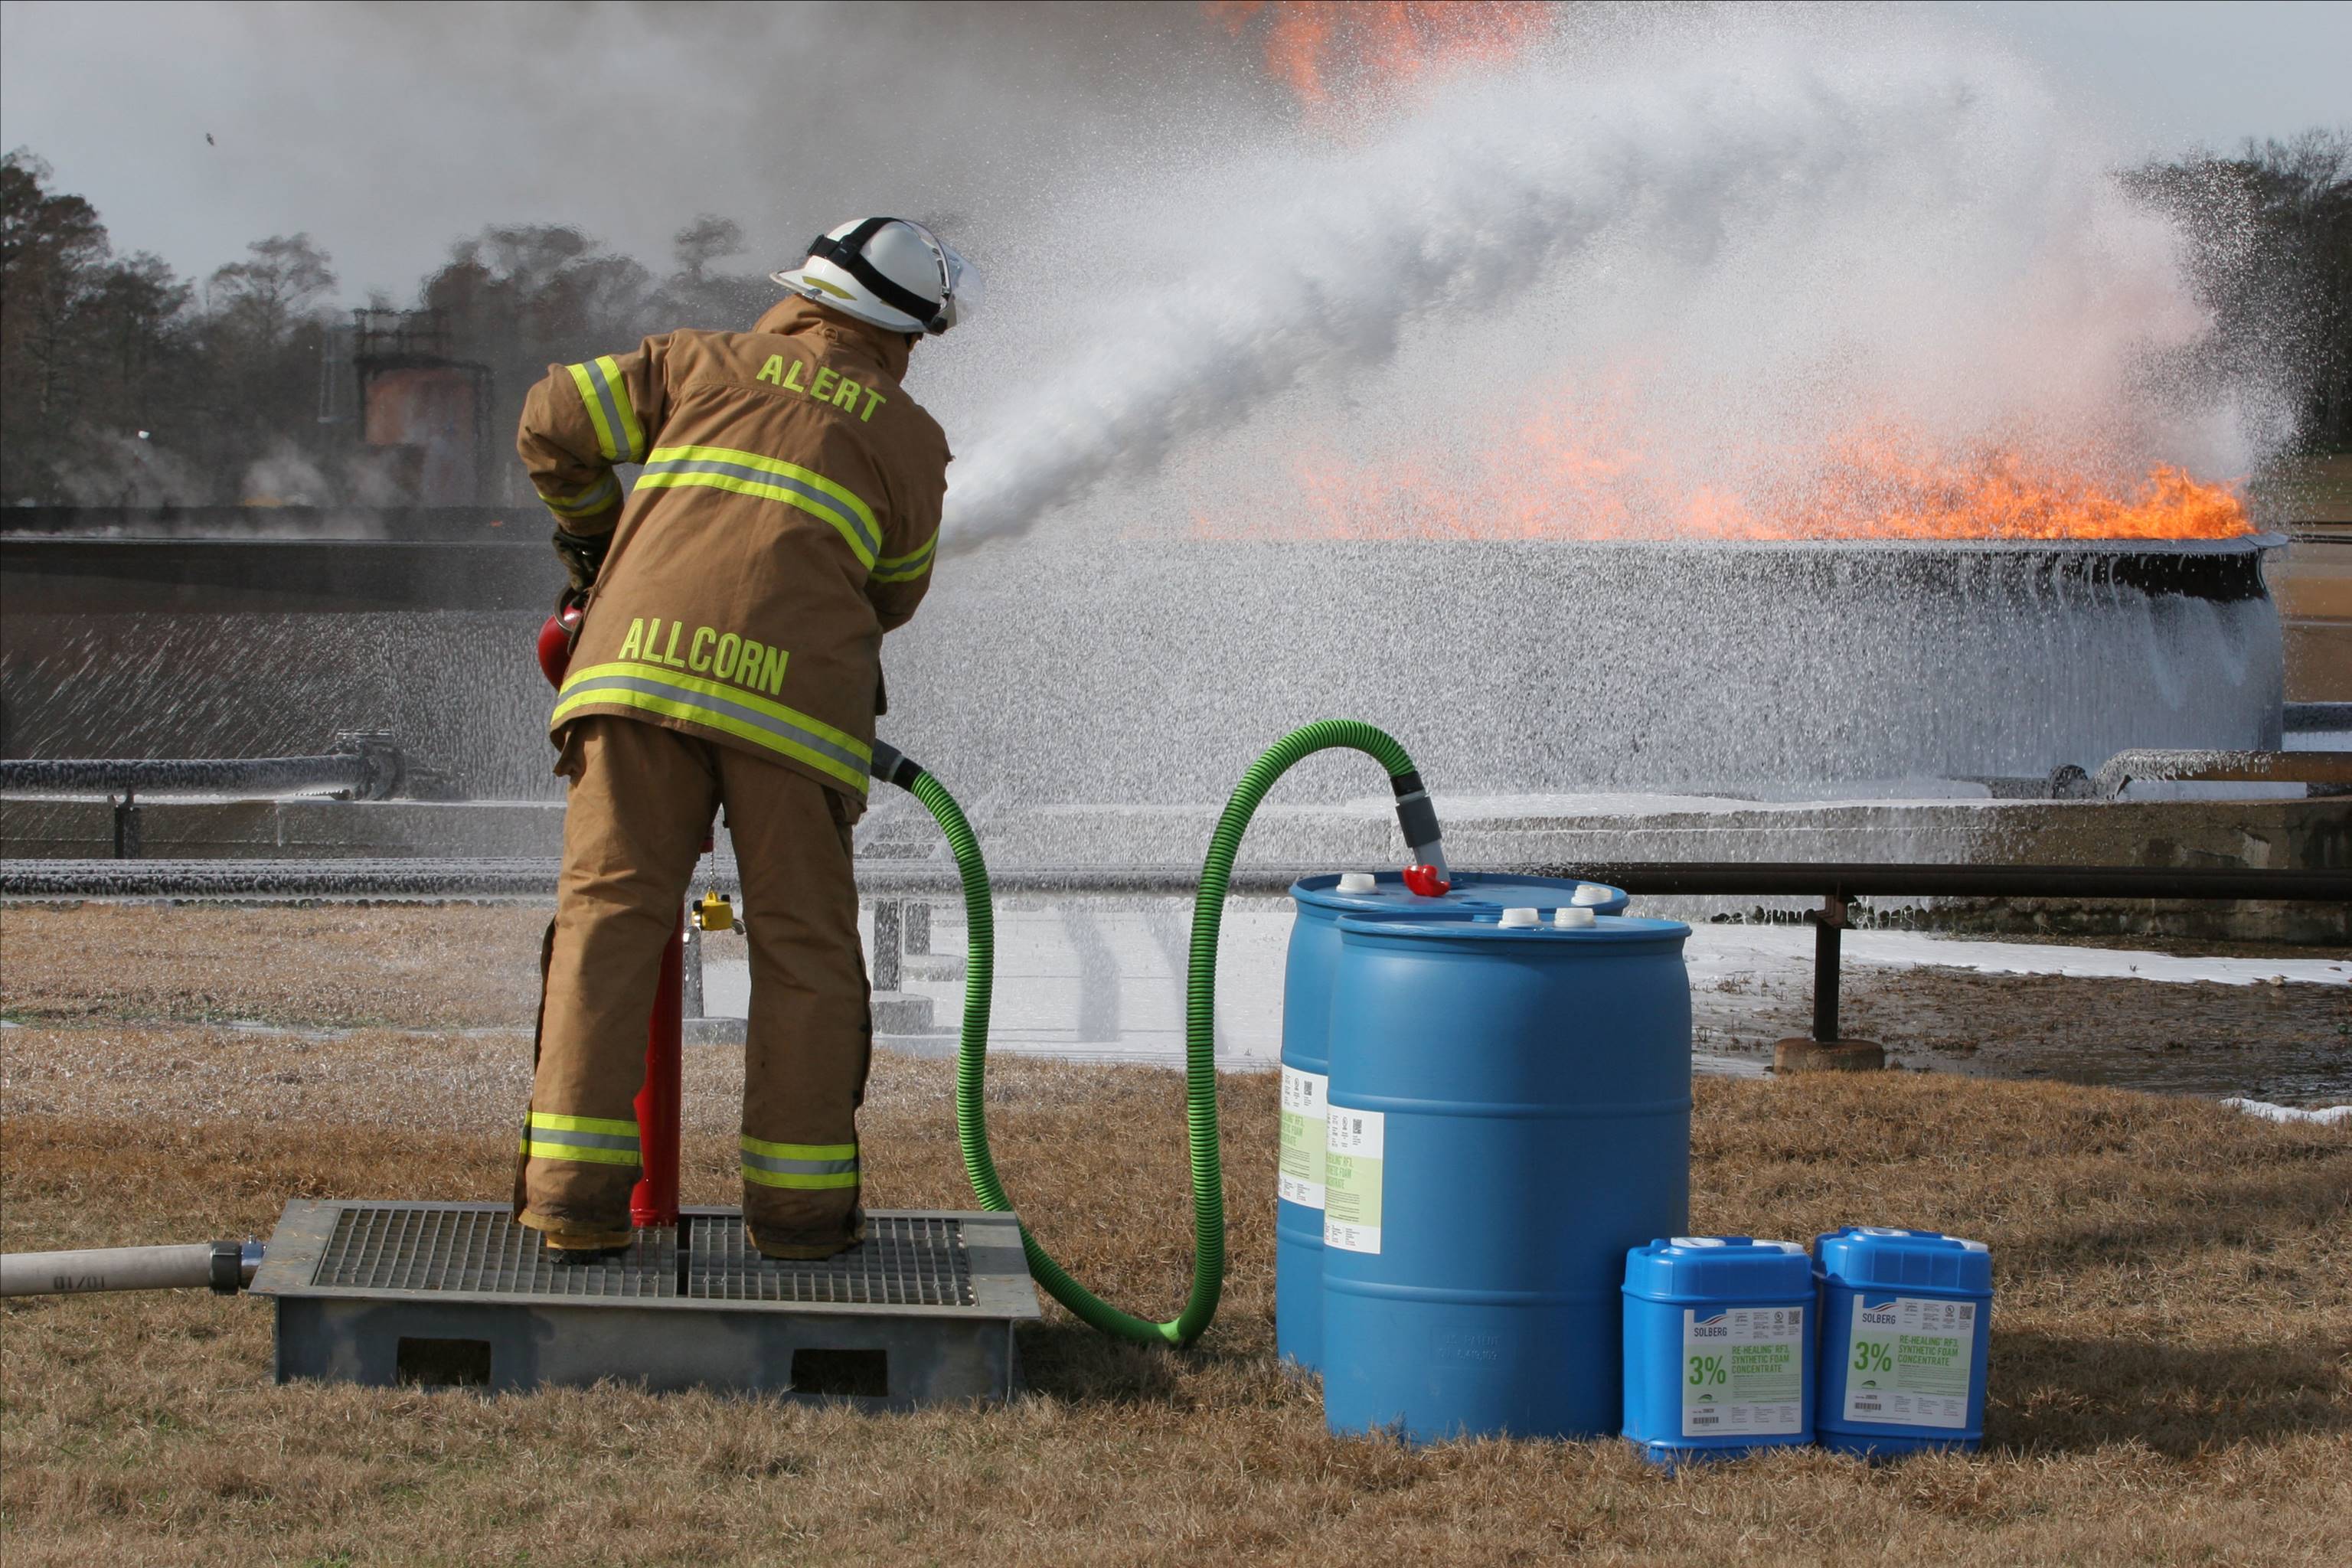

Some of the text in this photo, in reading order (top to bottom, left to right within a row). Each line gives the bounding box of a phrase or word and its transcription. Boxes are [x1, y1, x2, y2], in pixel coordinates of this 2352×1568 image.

[756, 354, 887, 423] ALERT
[618, 617, 790, 696] ALLCORN
[1862, 1312, 1896, 1325] SOLBERG
[1694, 1326, 1728, 1338] SOLBERG
[1854, 1341, 1892, 1373] 3%
[1898, 1345, 1958, 1357] SYNTHETIC FOAM
[1732, 1354, 1789, 1364] SYNTHETIC FOAM
[1898, 1355, 1950, 1367] CONCENTRATE
[1689, 1355, 1726, 1386] 3%
[1731, 1364, 1782, 1374] CONCENTRATE
